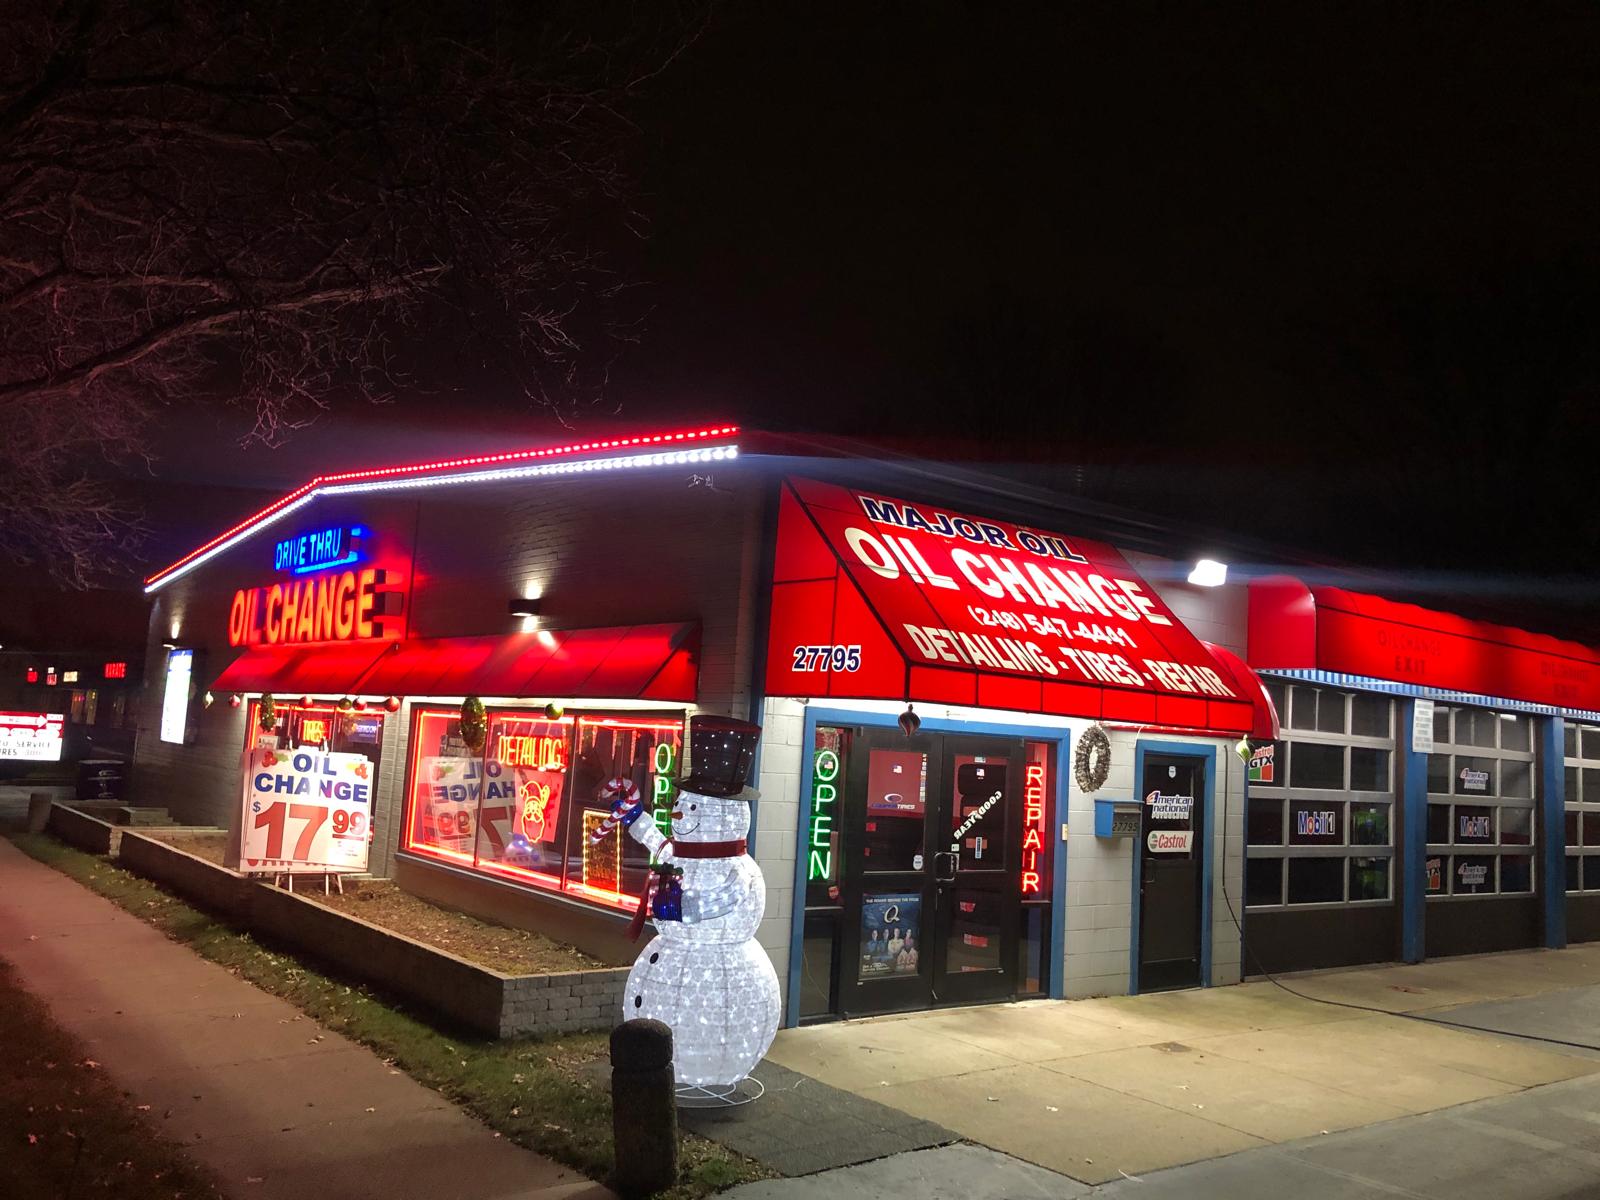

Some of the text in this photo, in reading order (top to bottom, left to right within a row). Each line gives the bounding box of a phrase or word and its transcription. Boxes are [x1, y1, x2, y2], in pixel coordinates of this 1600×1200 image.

[858, 496, 1088, 564] MAJOR OIL
[275, 527, 342, 570] DRIVE THRU
[845, 528, 1173, 626] OIL CHANGE
[230, 568, 376, 647] OIL CHANGE
[967, 605, 1138, 648] (248) 547-4441
[792, 645, 861, 672] 27795
[903, 624, 1059, 675] DETAILING
[1058, 646, 1145, 687] TIRES
[1142, 659, 1236, 698] REPAIR
[1394, 655, 1426, 675] EXIT
[293, 753, 337, 776] OIL
[1249, 755, 1273, 768] GTX
[1254, 745, 1274, 758] astrol
[254, 772, 368, 803] CHANGE
[1146, 790, 1194, 806] American
[332, 809, 367, 835] 99
[809, 750, 839, 880] OPEN
[1152, 804, 1190, 813] national
[1022, 766, 1044, 892] REPAIR
[1112, 822, 1139, 832] 27795
[1158, 833, 1187, 849] Castrol
